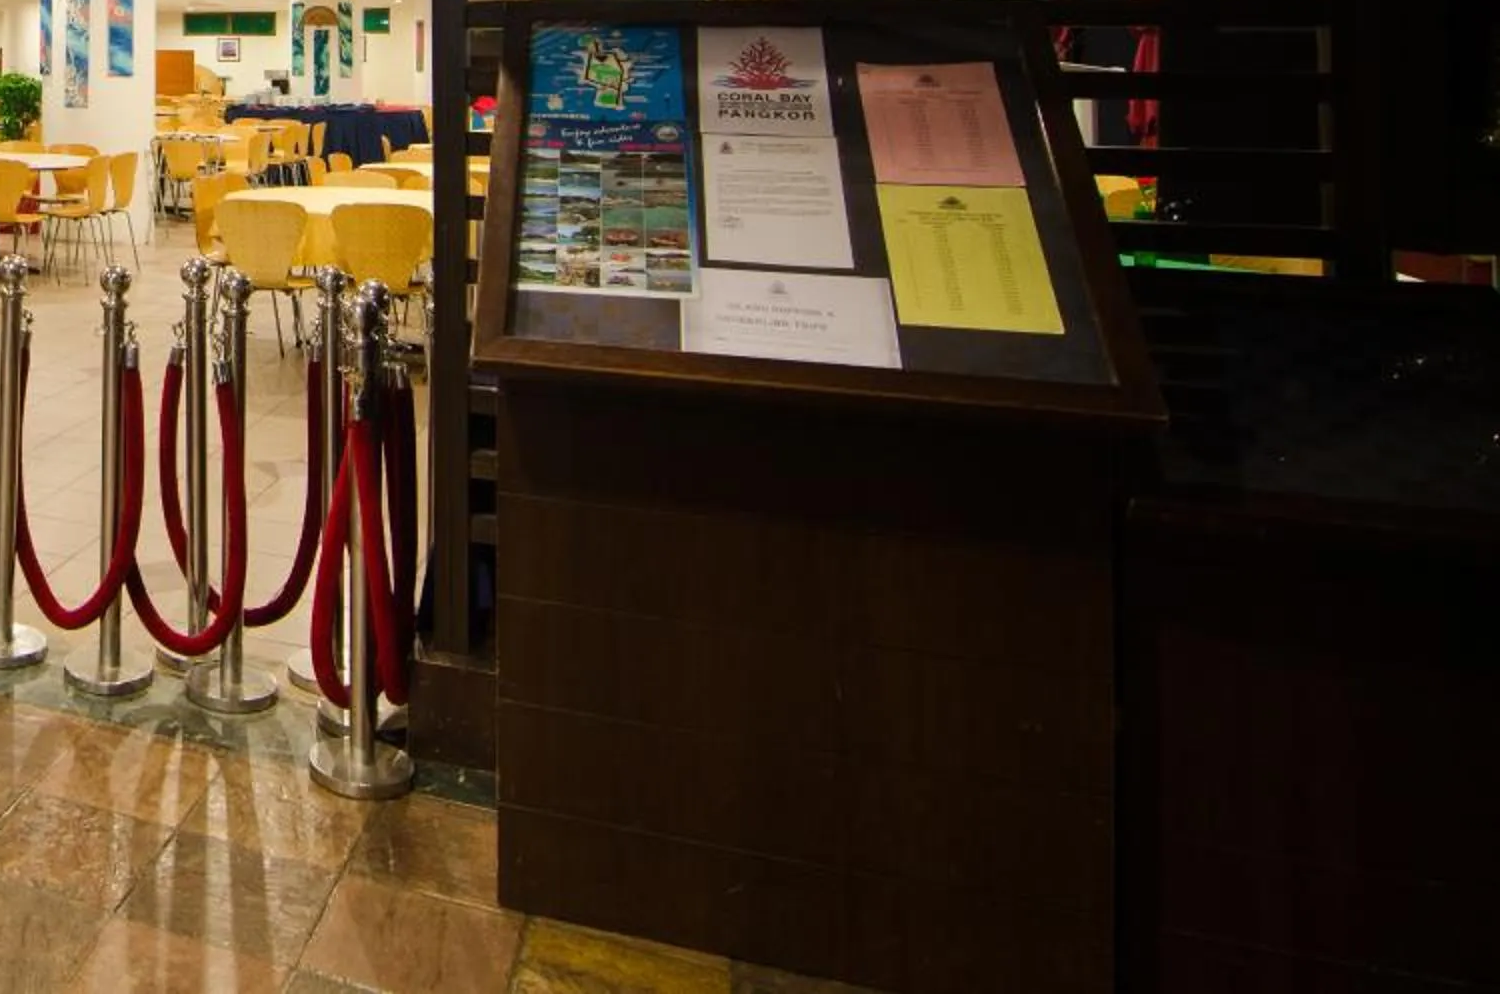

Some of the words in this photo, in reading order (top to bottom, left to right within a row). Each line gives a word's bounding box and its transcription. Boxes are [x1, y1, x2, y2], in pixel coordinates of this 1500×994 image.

[718, 92, 773, 102] CORAL
[780, 93, 812, 103] BAY
[718, 109, 816, 121] PANGKOR
